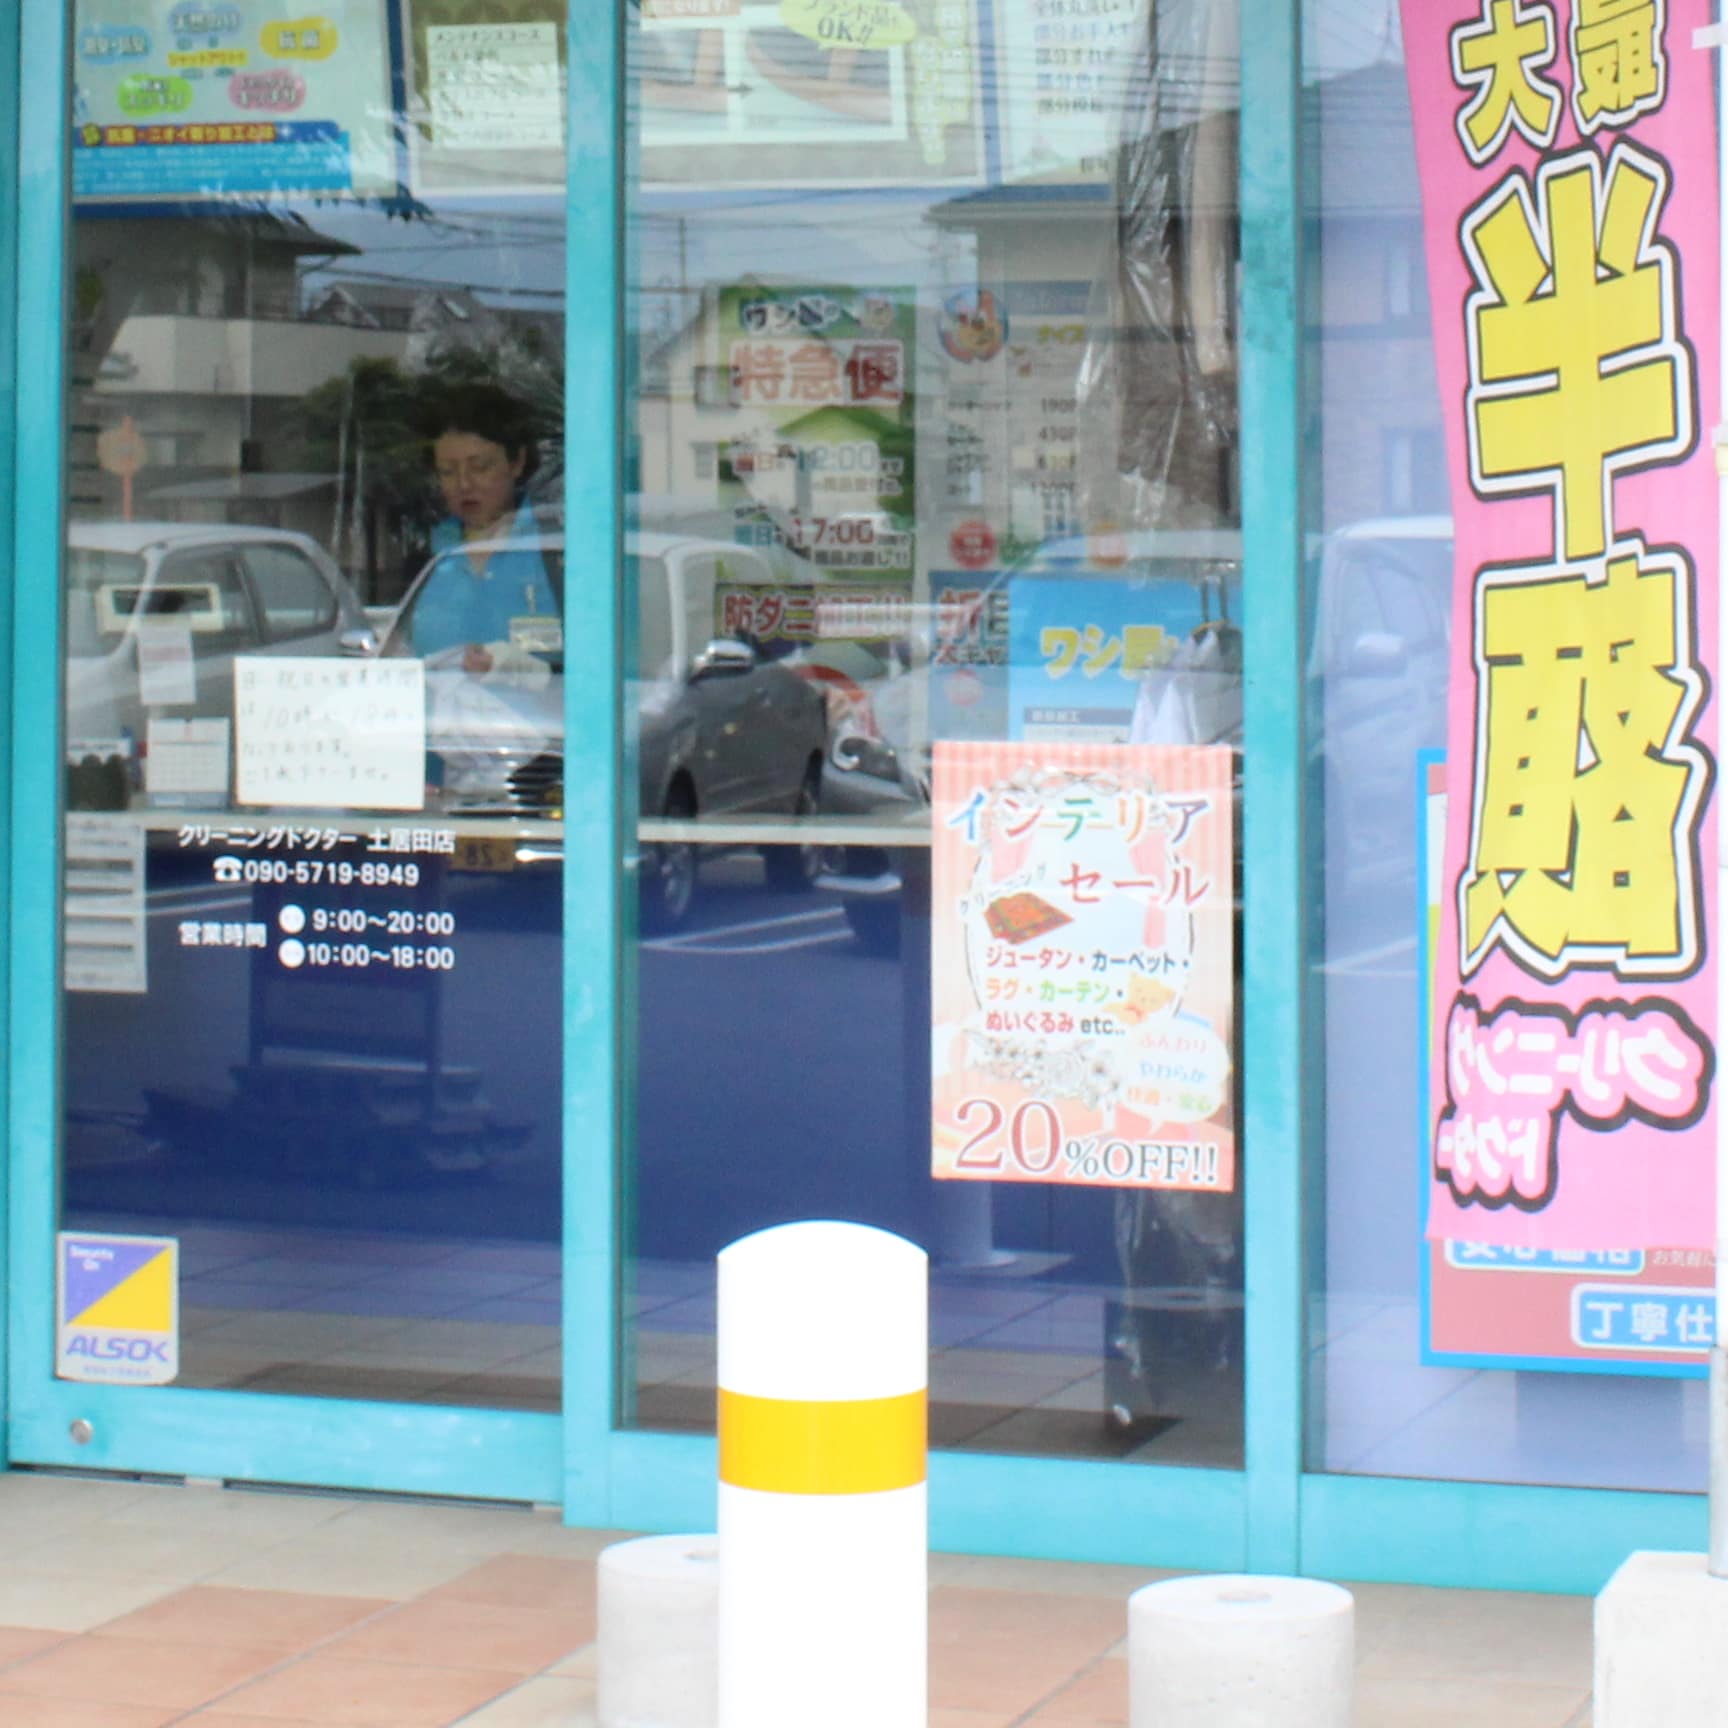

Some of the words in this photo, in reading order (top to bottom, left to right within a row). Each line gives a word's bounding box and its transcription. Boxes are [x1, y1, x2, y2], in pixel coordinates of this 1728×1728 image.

[734, 344, 904, 401] 特急便
[949, 791, 1210, 843] インテリア
[178, 824, 358, 851] クリーニングドクター
[366, 827, 457, 854] 土居田店
[244, 858, 421, 888] 090-5719-8949
[1059, 861, 1210, 906] セール
[178, 922, 267, 948] 営業時間
[985, 1010, 1074, 1034] ぬいぐるみ
[955, 1099, 1217, 1182] 20%OFF!!
[66, 1334, 170, 1362] ALSOK
